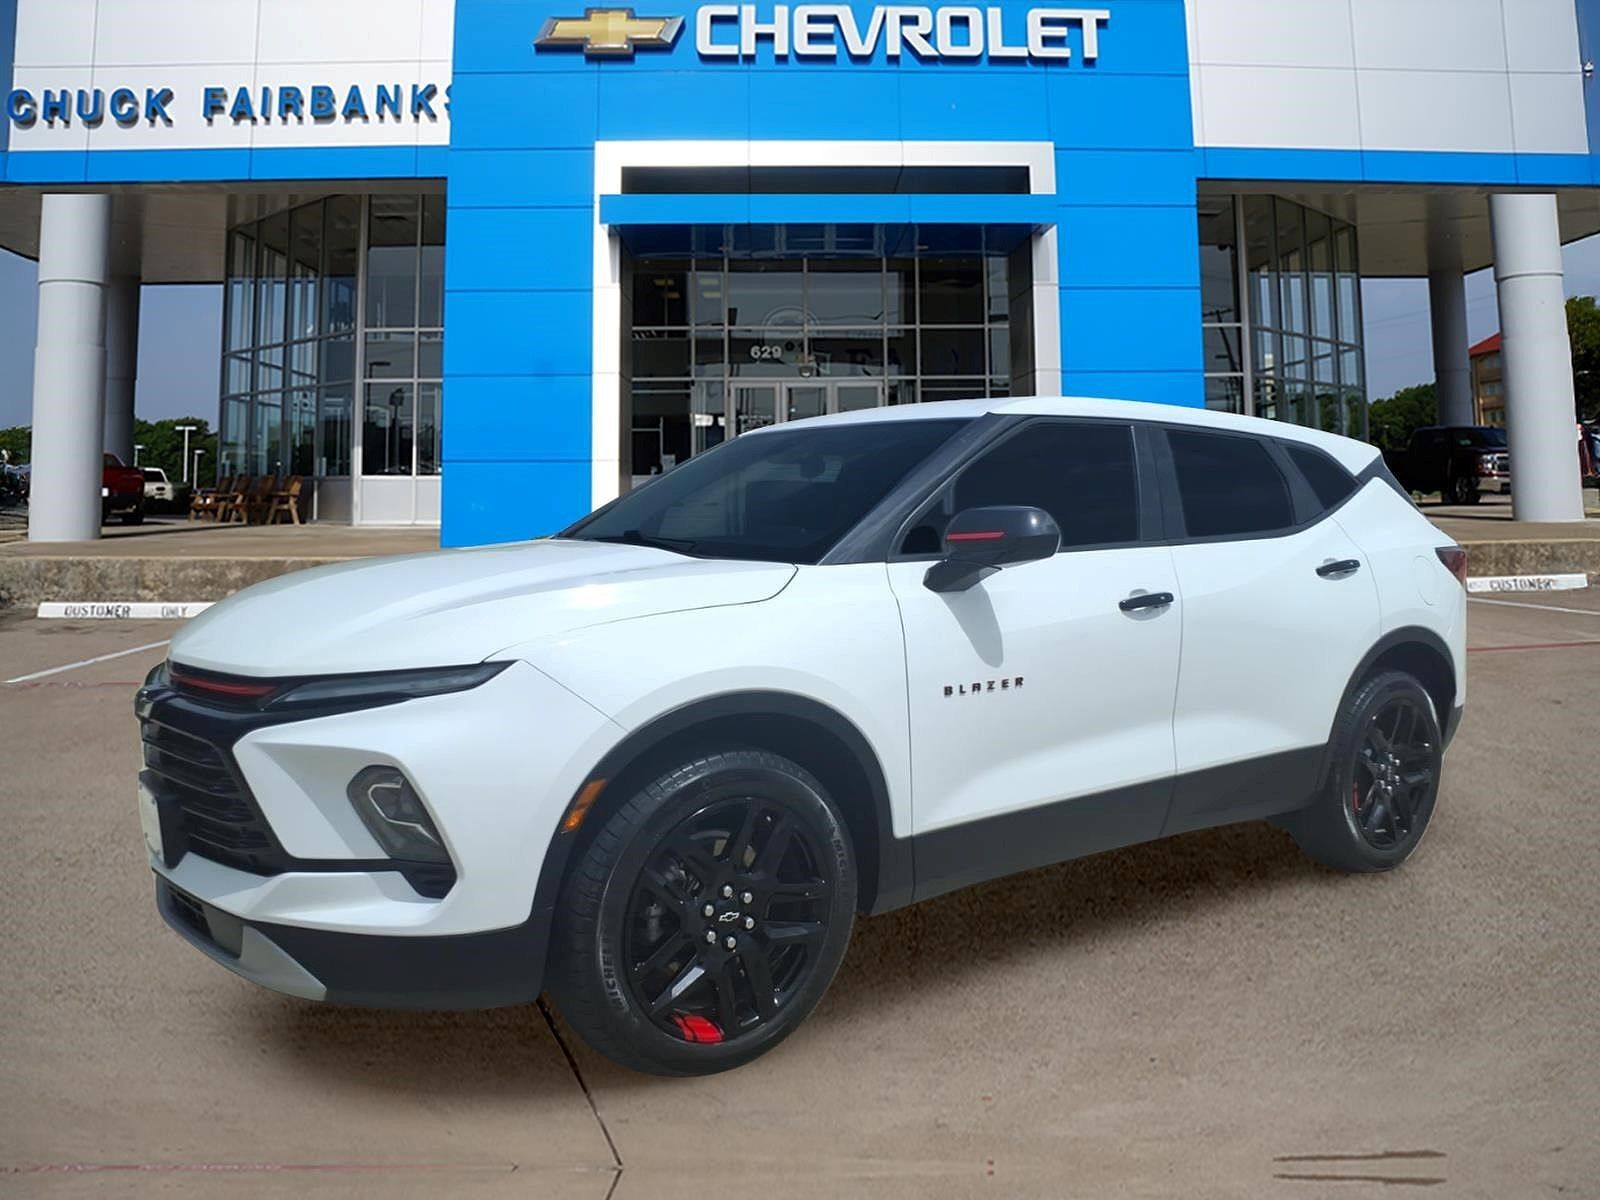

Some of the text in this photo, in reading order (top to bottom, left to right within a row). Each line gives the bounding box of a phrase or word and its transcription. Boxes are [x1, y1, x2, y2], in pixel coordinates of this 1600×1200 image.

[696, 5, 1111, 59] CHEVROLET
[7, 84, 452, 127] CHUCK FAIRBANK
[750, 345, 782, 359] 629
[1489, 578, 1552, 590] CUSTOMER
[64, 605, 131, 617] CUSTOMER
[944, 677, 1024, 697] BLAZER
